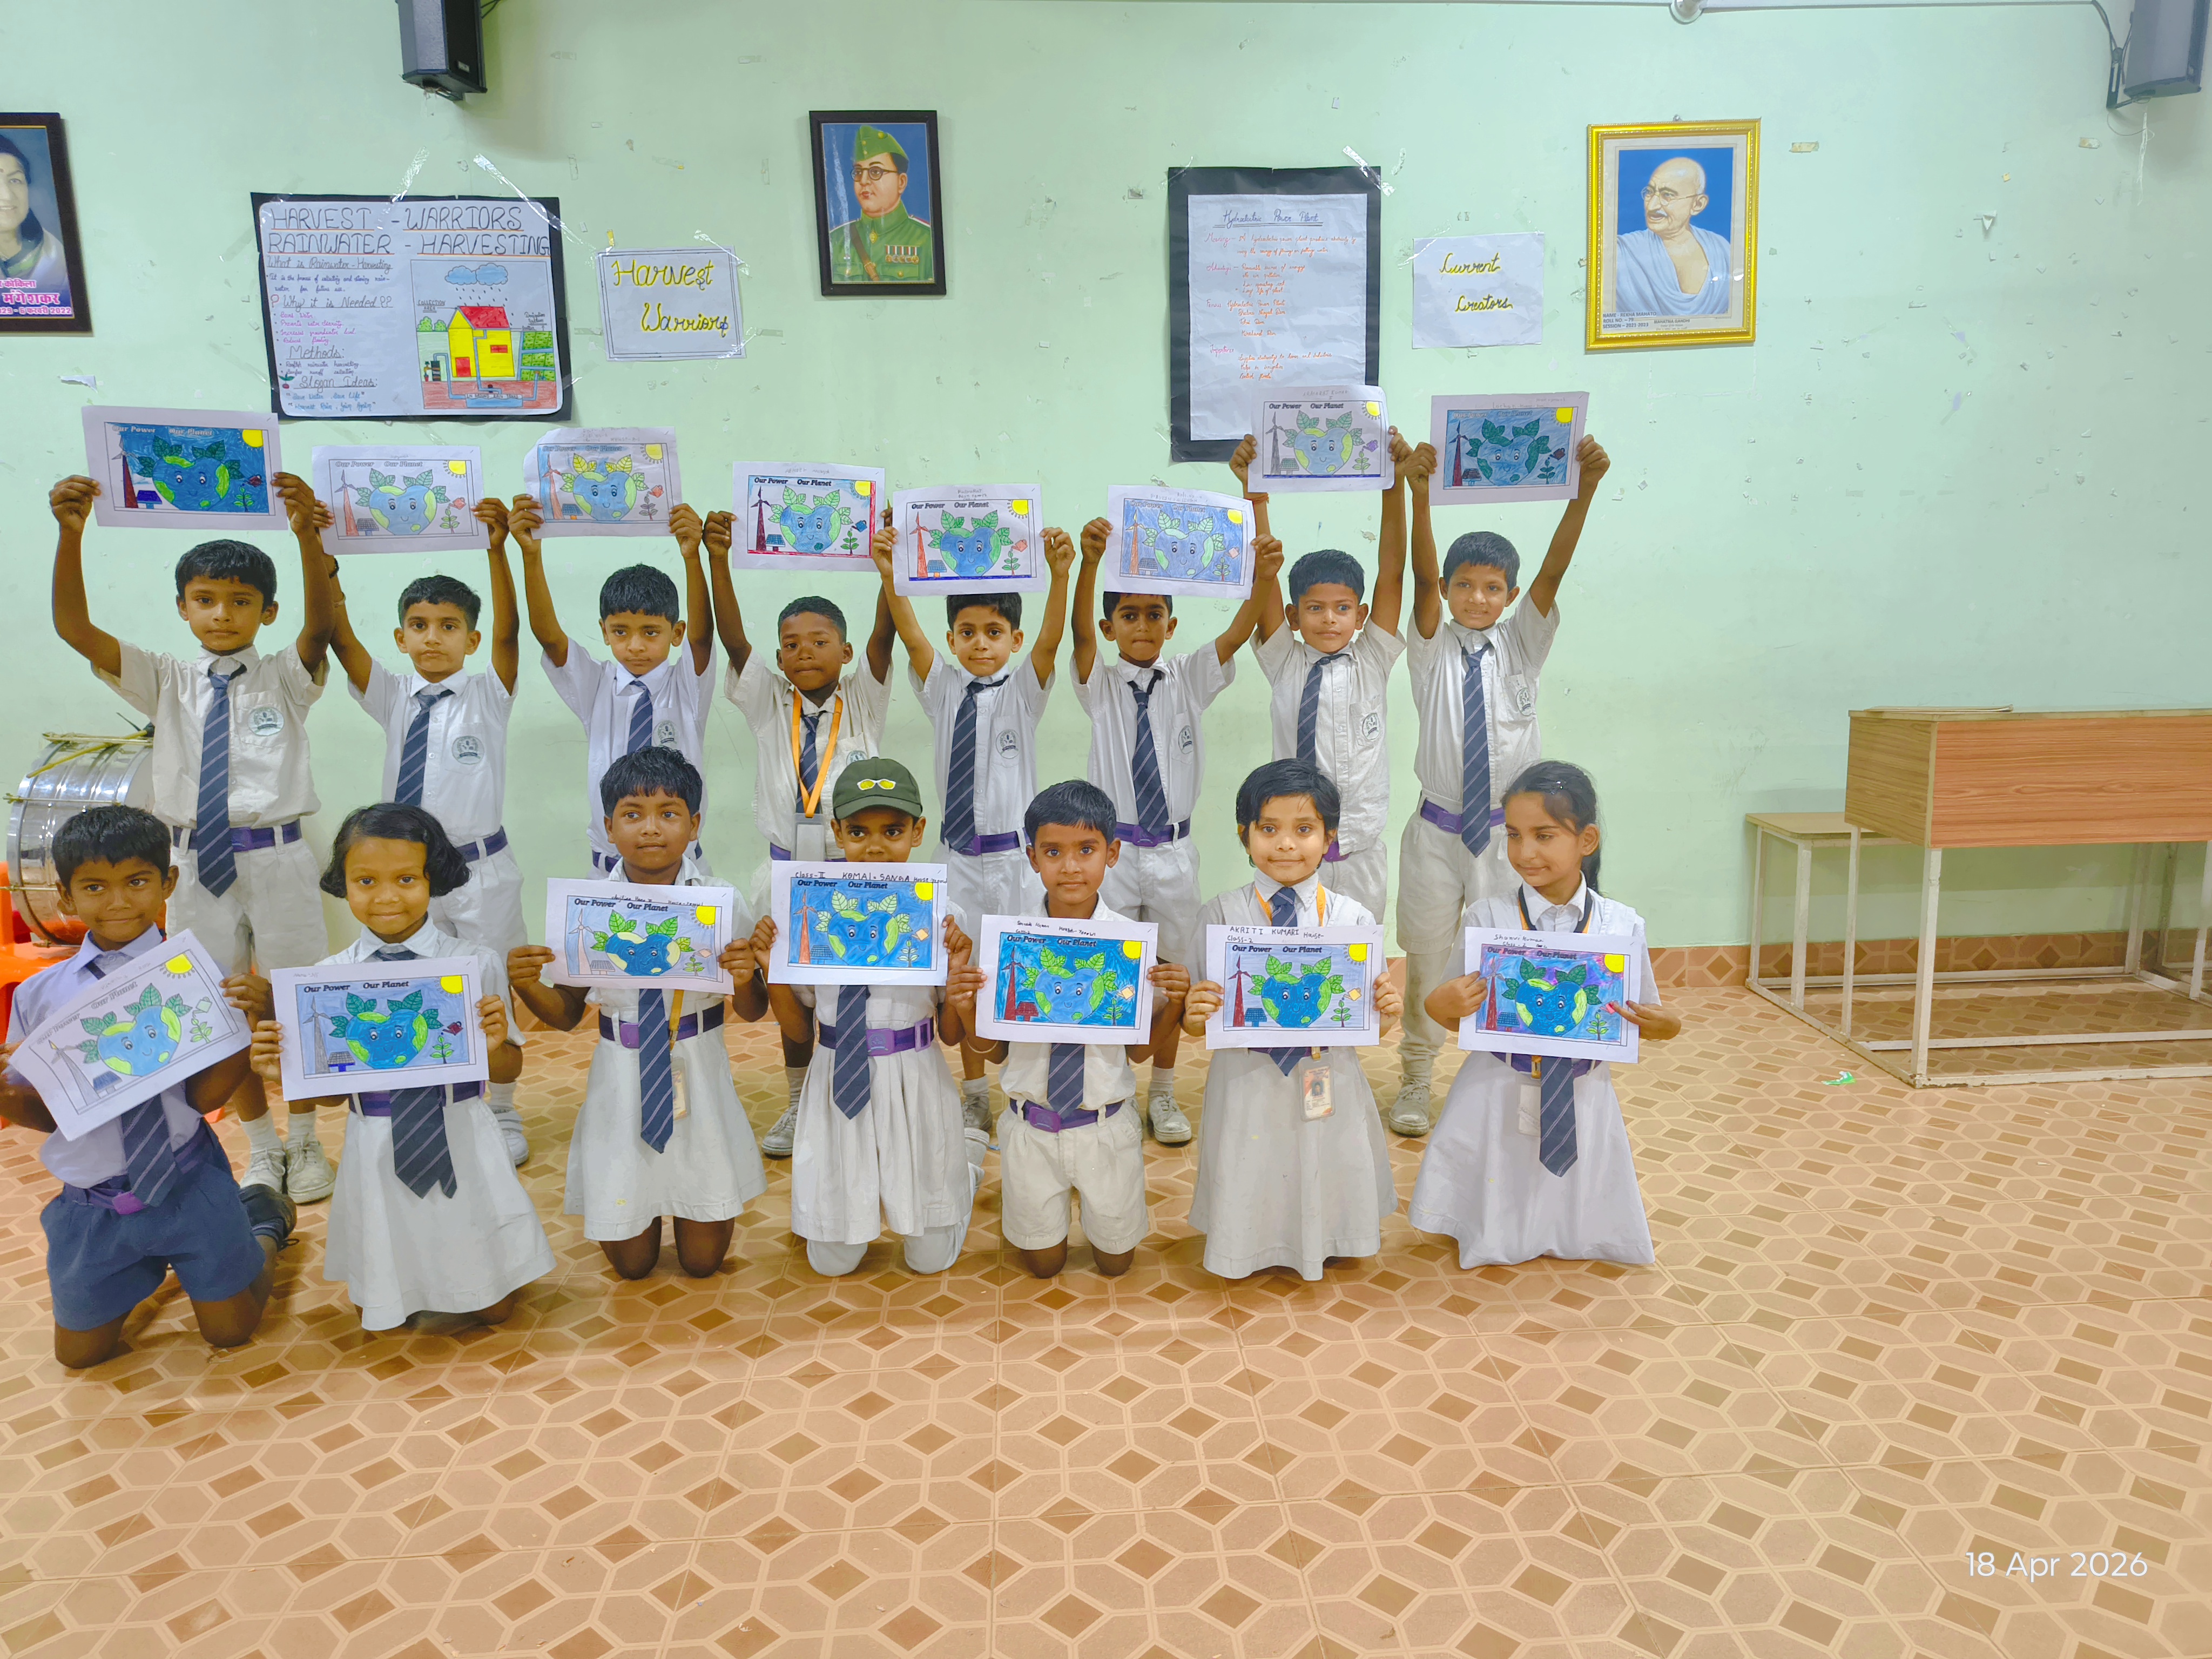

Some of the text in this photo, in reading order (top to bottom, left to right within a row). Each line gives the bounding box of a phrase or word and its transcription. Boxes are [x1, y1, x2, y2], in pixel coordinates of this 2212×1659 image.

[271, 206, 522, 230] HARVEST WARRIORS
[1273, 208, 1292, 222] Power
[1299, 211, 1319, 222] Plant
[268, 233, 550, 256] RAINWATER HARVESTING
[267, 255, 392, 274] What is Rainwater Harvesting
[1439, 252, 1501, 274] Current
[611, 259, 714, 291] Harvest
[2, 289, 60, 304] मंगेशकर
[283, 295, 305, 313] Why
[311, 298, 319, 308] it
[326, 298, 334, 308] is
[1455, 294, 1513, 312] Creators
[641, 302, 729, 338] Warriors
[299, 376, 335, 393] Slogan
[590, 899, 616, 908] Power
[627, 902, 642, 910] Our
[643, 903, 669, 912] Planet
[1229, 926, 1264, 935] AKRITI
[1022, 936, 1047, 944] Power
[1502, 947, 1527, 955] Power
[1552, 952, 1577, 960] Planet
[91, 997, 109, 1009] Our
[109, 981, 138, 1001] Planet
